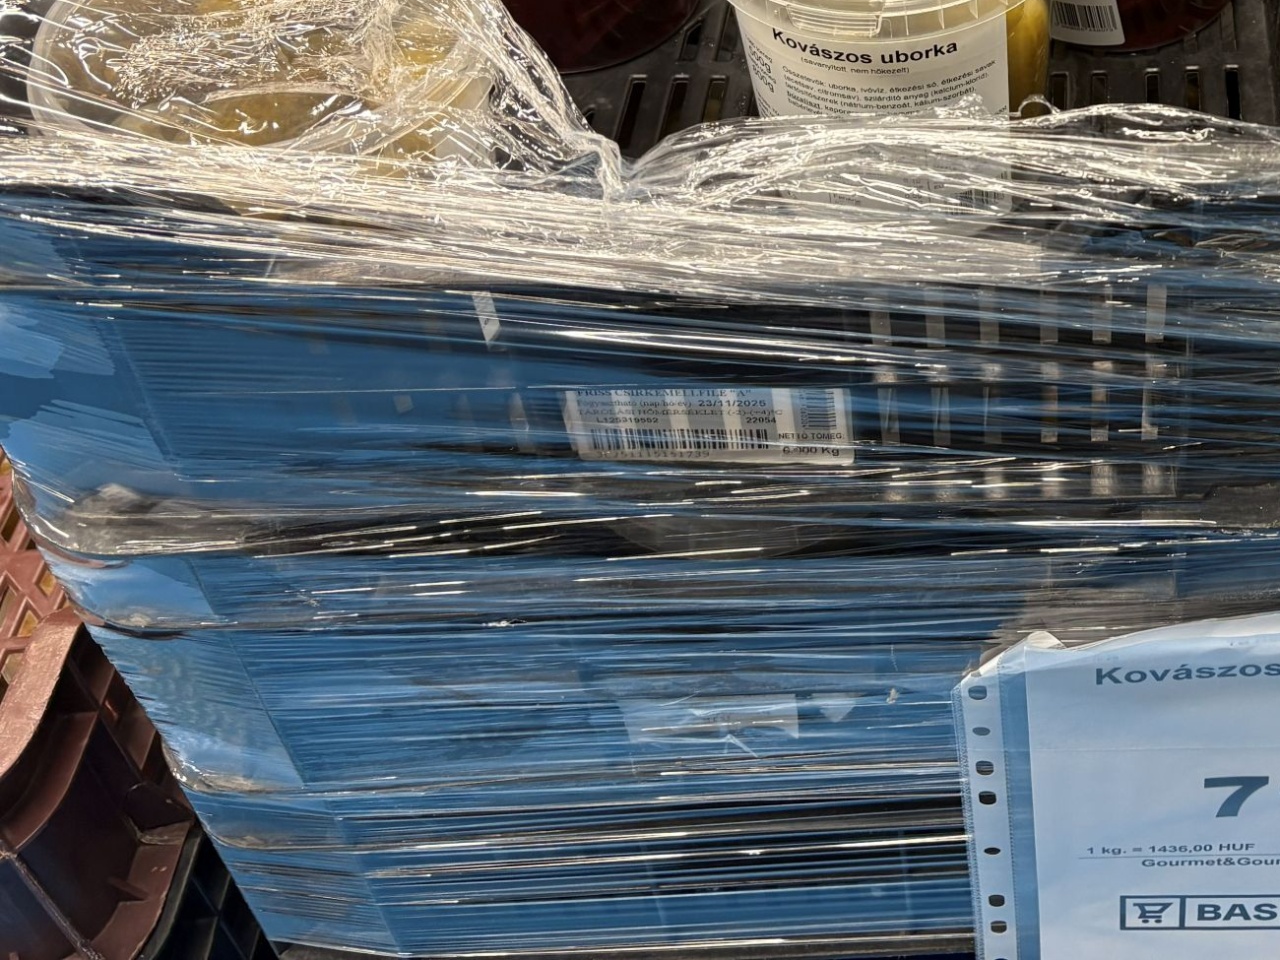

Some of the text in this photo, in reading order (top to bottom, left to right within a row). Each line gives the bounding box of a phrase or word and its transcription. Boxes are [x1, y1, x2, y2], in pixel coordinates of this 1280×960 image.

[772, 27, 958, 65] Kovászos uborka
[698, 399, 767, 407] 23/11/2025
[821, 446, 840, 457] Kg
[1101, 845, 1127, 856] kg.
[1149, 843, 1213, 854] 1436,00
[1218, 843, 1256, 852] HUF
